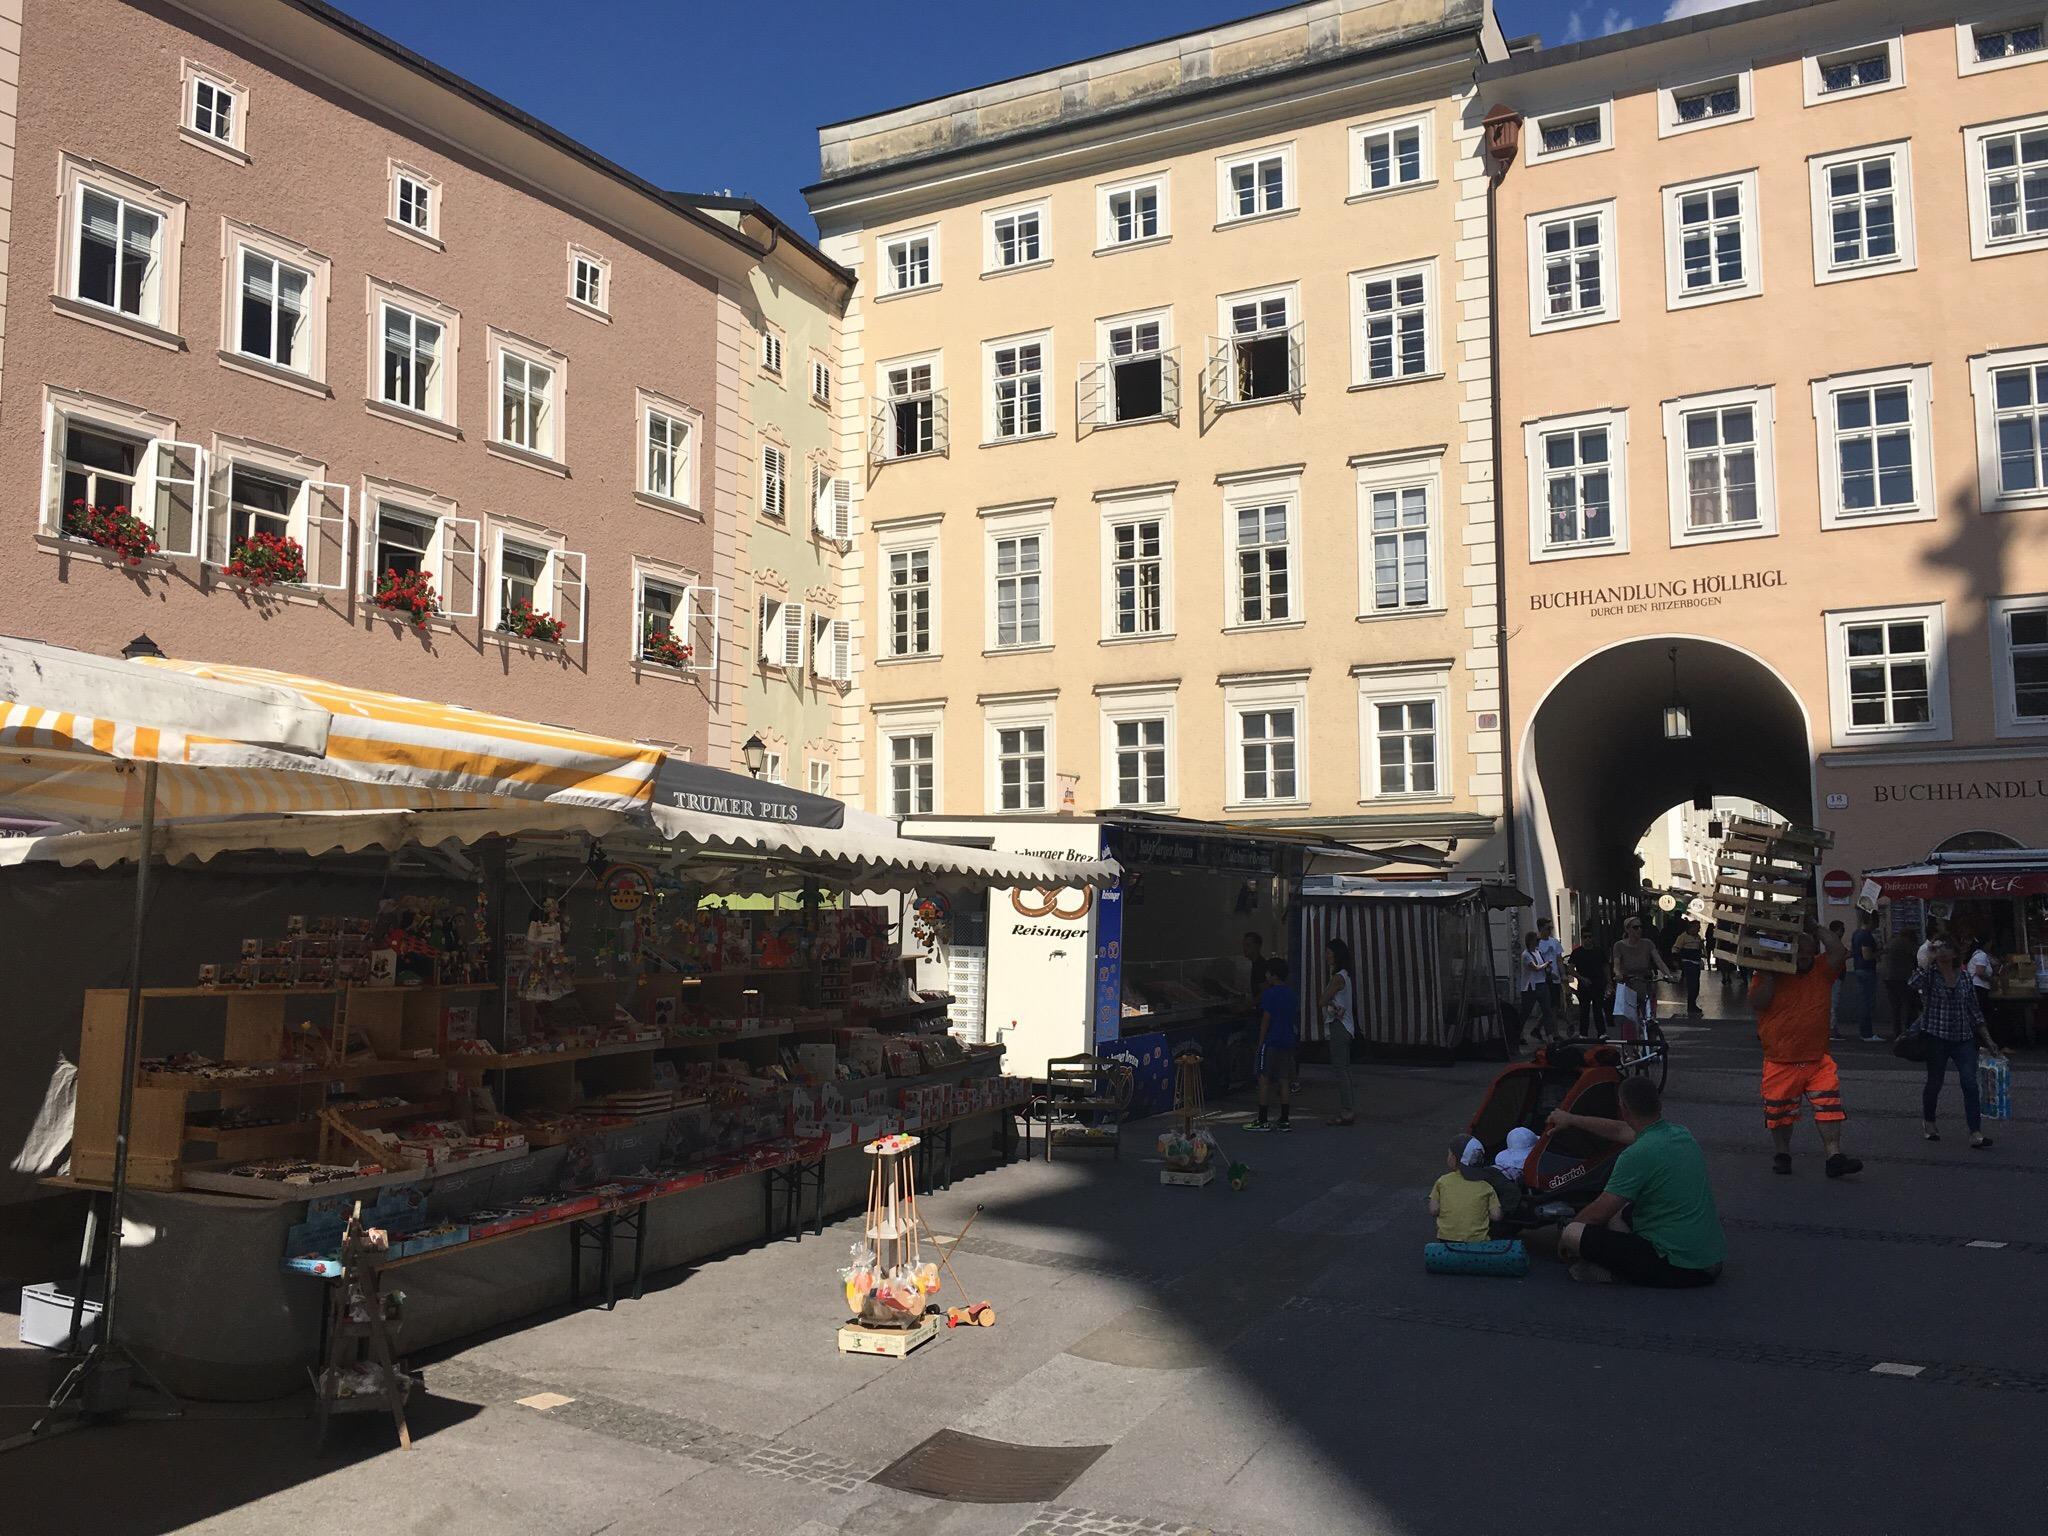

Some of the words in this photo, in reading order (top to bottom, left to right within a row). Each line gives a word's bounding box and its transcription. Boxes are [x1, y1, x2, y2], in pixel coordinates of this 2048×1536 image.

[1530, 580, 1687, 611] BUCHHANDLUNG
[1692, 570, 1787, 595] HÖLLRIGL
[1590, 605, 1624, 617] DURCH
[1627, 602, 1648, 613] DEN
[1651, 596, 1723, 611] RITZERBOGEN
[1874, 779, 2048, 802] BUCHHANDLU
[673, 791, 754, 817] TRUMER
[759, 802, 798, 821] PILS
[1954, 875, 2024, 892] MAYER
[1011, 924, 1089, 940] Reisinger
[1549, 1164, 1586, 1190] chariot
